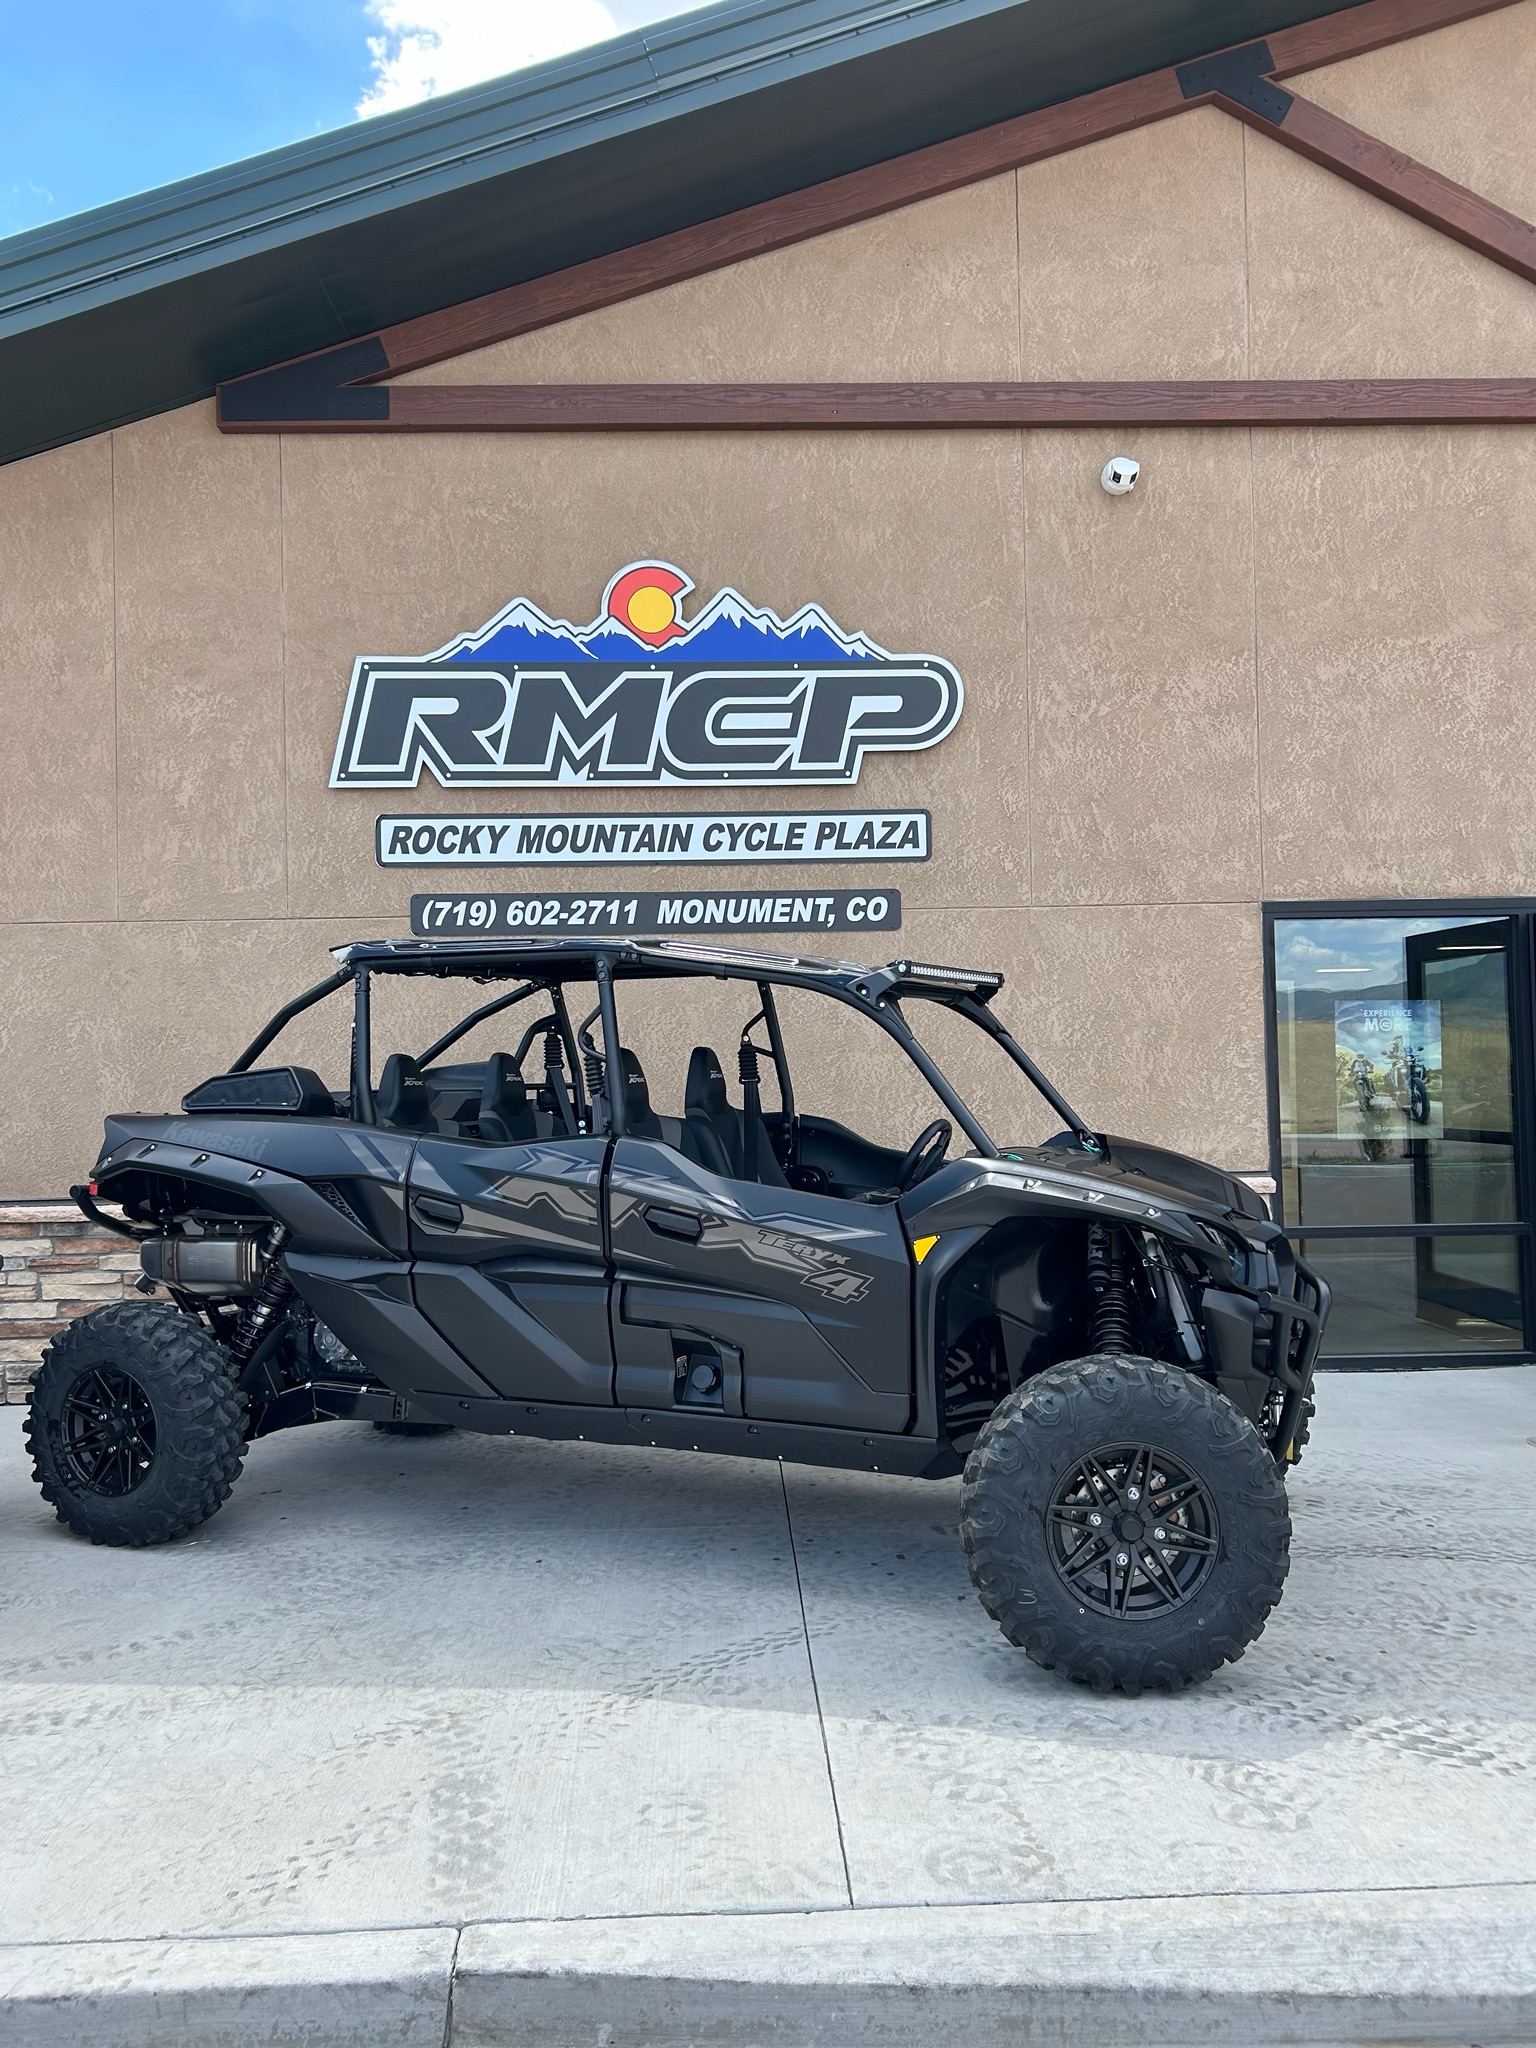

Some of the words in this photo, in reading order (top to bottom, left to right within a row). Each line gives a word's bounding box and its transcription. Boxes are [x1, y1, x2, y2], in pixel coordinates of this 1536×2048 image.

[348, 669, 950, 772] RMCP
[388, 825, 510, 855] ROCKY
[516, 823, 694, 854] MOUNTAIN
[702, 822, 807, 852] CYCLE
[814, 820, 920, 851] PLAZA
[422, 899, 497, 930] (719)
[506, 899, 639, 926] 602-2711
[656, 897, 835, 929] MONUMENT,
[846, 896, 889, 922] CO
[1363, 1009, 1413, 1018] EXPERIENCE
[161, 1120, 271, 1162] Kawasaki
[1013, 1164, 1085, 1185] BLACKOUT
[1089, 1178, 1142, 1199] EDITION
[758, 1230, 852, 1265] TERYX
[1088, 1222, 1111, 1260] FOX
[804, 1269, 870, 1302] 4
